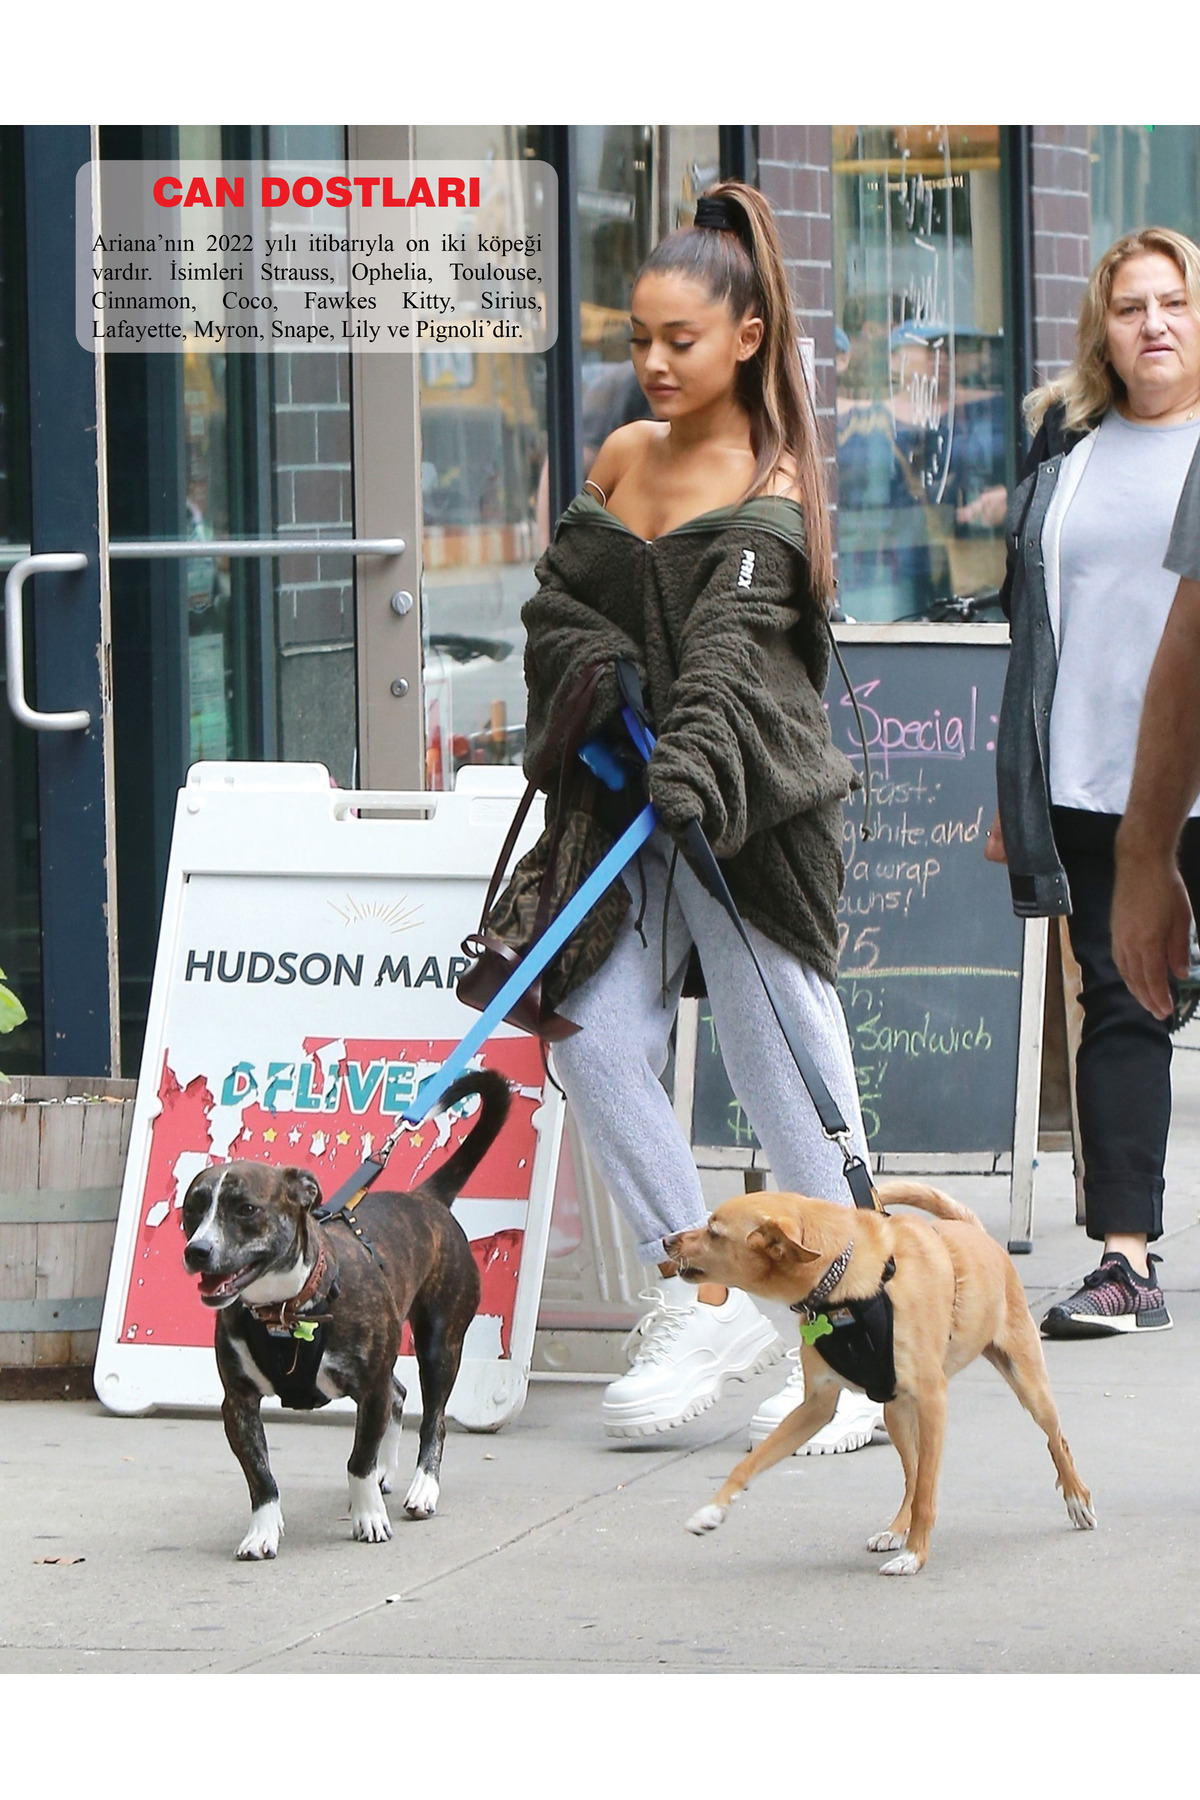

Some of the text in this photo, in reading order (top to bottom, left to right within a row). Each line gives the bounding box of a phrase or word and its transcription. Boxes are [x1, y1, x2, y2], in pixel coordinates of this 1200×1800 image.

[931, 806, 983, 843] and
[876, 858, 941, 897] wrap
[184, 949, 364, 987] HUDSON
[857, 1011, 992, 1057] Sandwich
[221, 1061, 446, 1118] DELIVE
